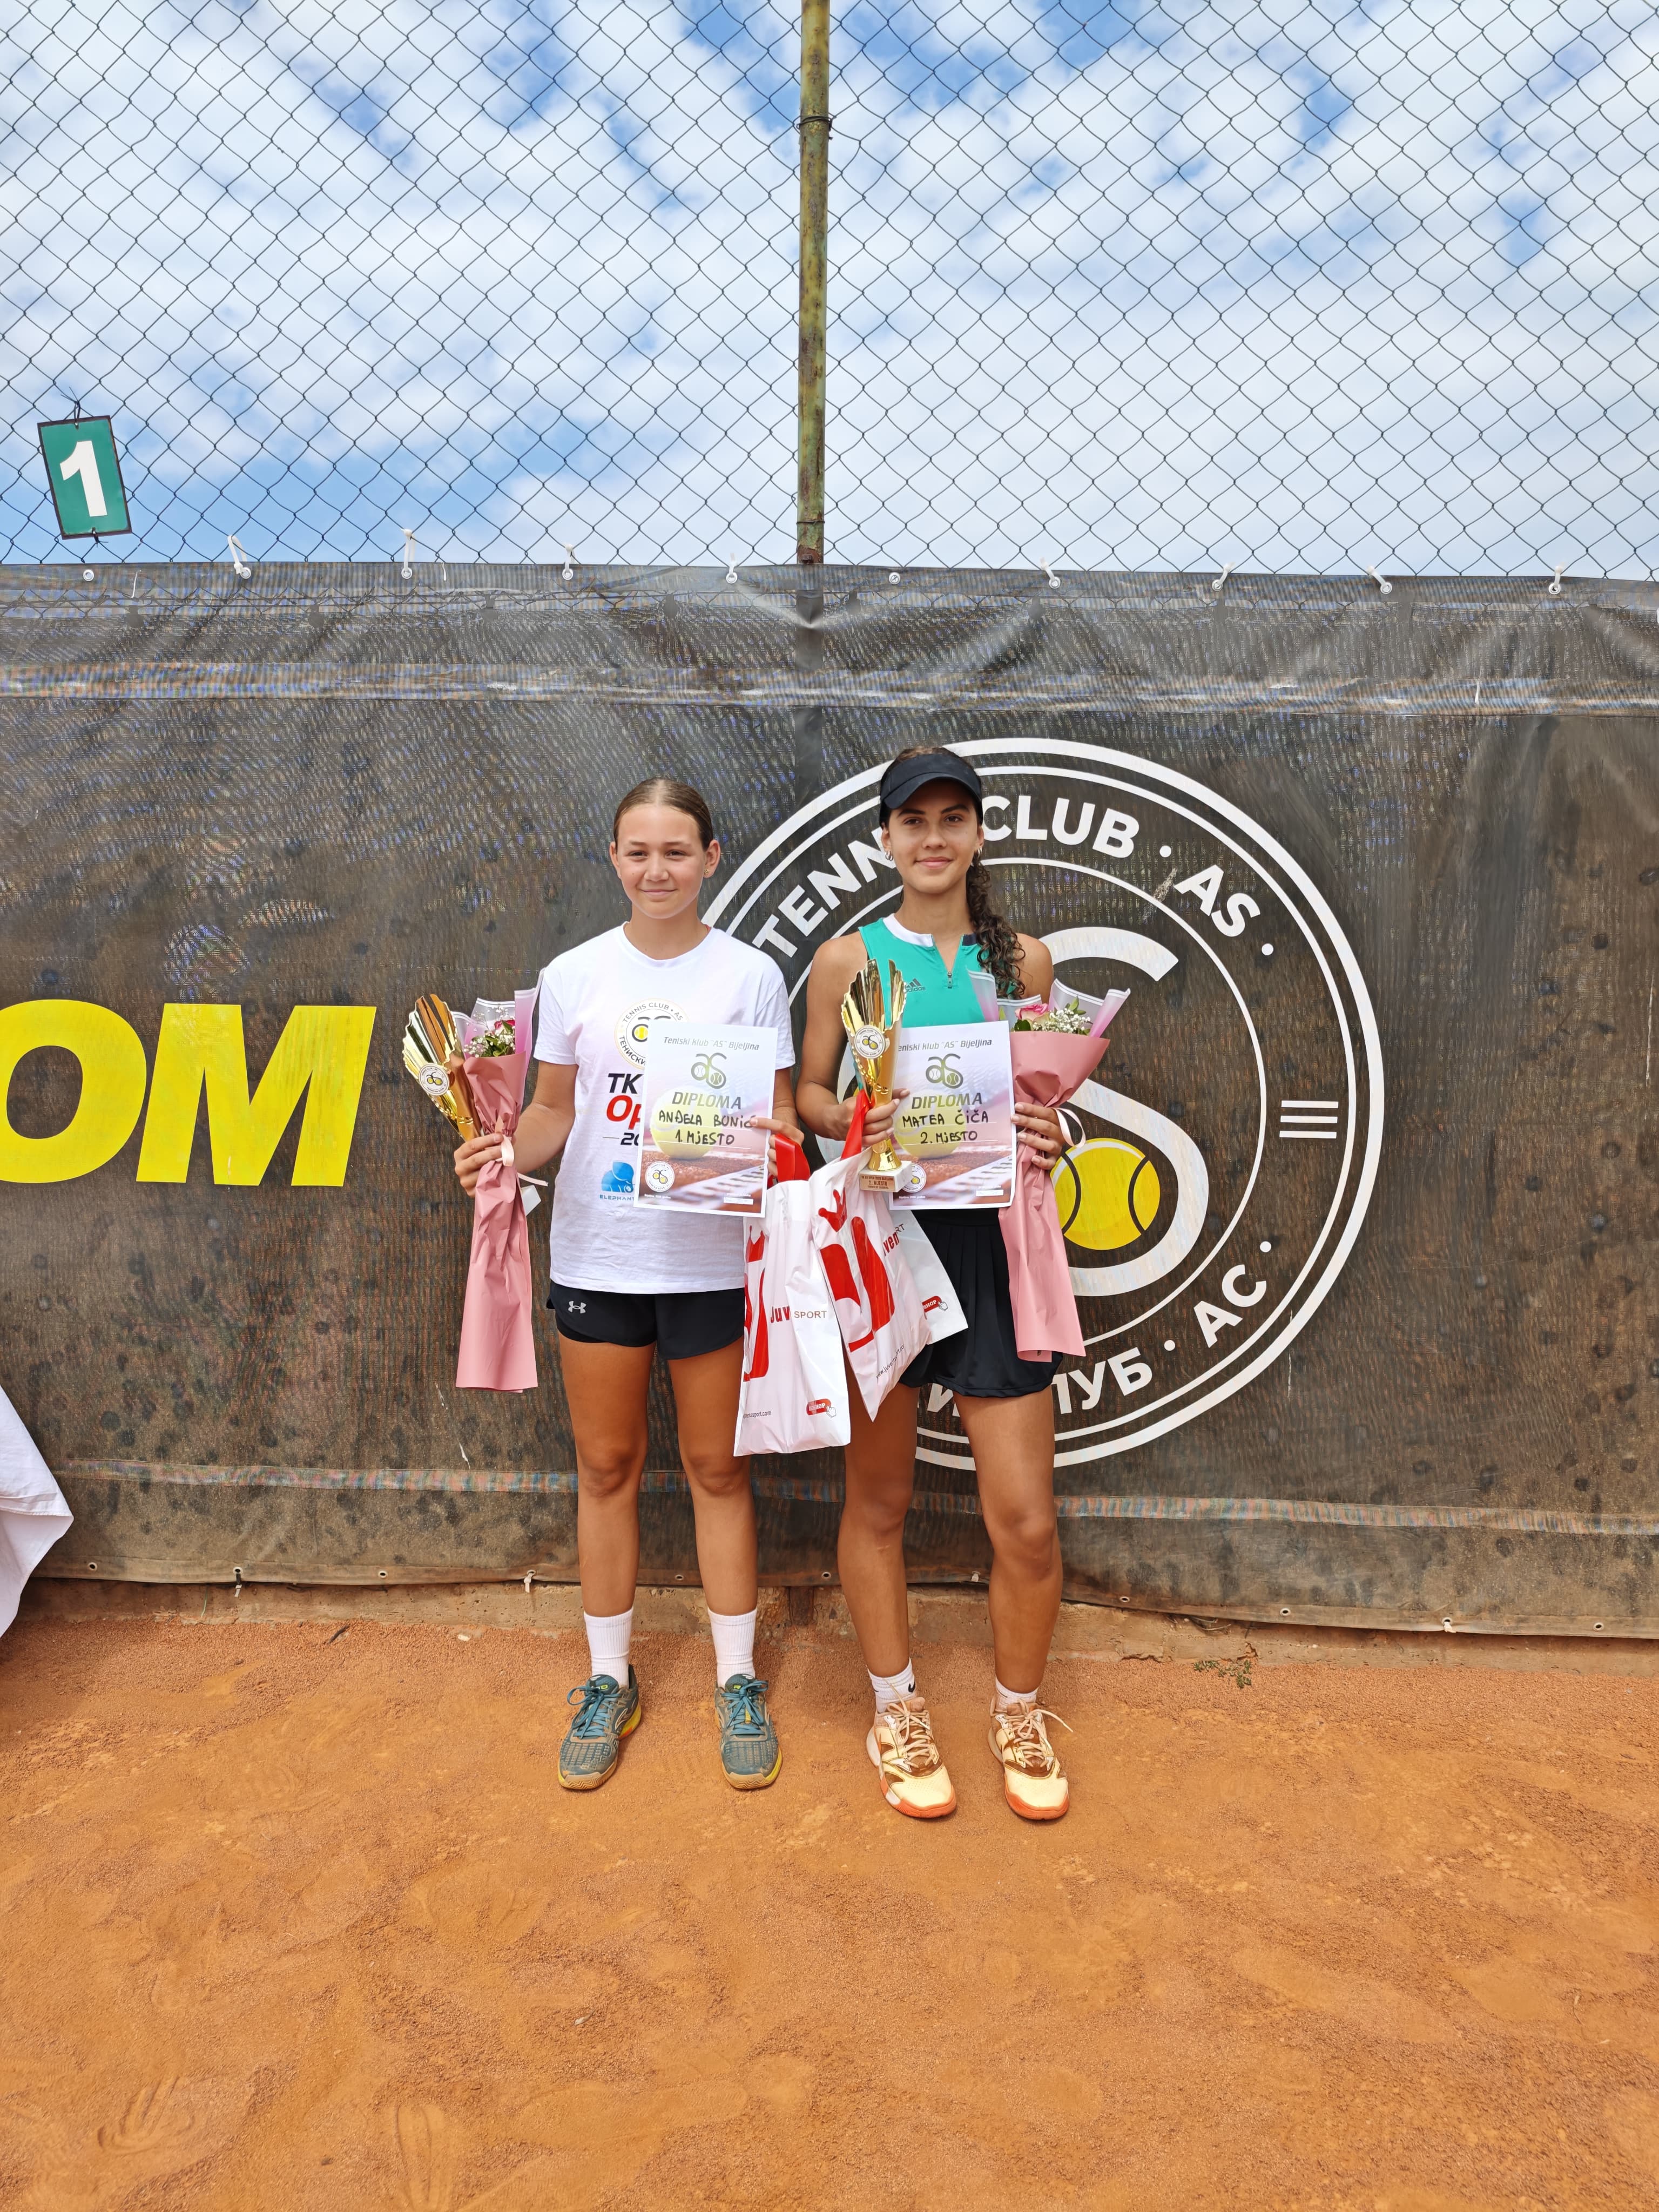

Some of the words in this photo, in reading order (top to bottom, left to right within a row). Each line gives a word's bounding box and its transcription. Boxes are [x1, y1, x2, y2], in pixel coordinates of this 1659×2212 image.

[59, 440, 108, 517] 1
[752, 827, 896, 957] TENN
[982, 795, 1139, 858] CLUB
[1174, 865, 1260, 937] AS
[623, 1004, 646, 1022] TENNIS
[674, 1012, 683, 1021] AS
[664, 1036, 690, 1046] Teniski
[729, 1041, 759, 1050] Bijeljina
[922, 1042, 940, 1050] klub
[960, 1039, 992, 1048] Bijeljina
[608, 1073, 644, 1094] TK
[672, 1091, 741, 1109] DIPLOMA
[912, 1092, 982, 1109] DIPLOMA
[902, 1114, 945, 1128] MATEA
[920, 1131, 933, 1144] 2.
[794, 1311, 827, 1319] SPORT
